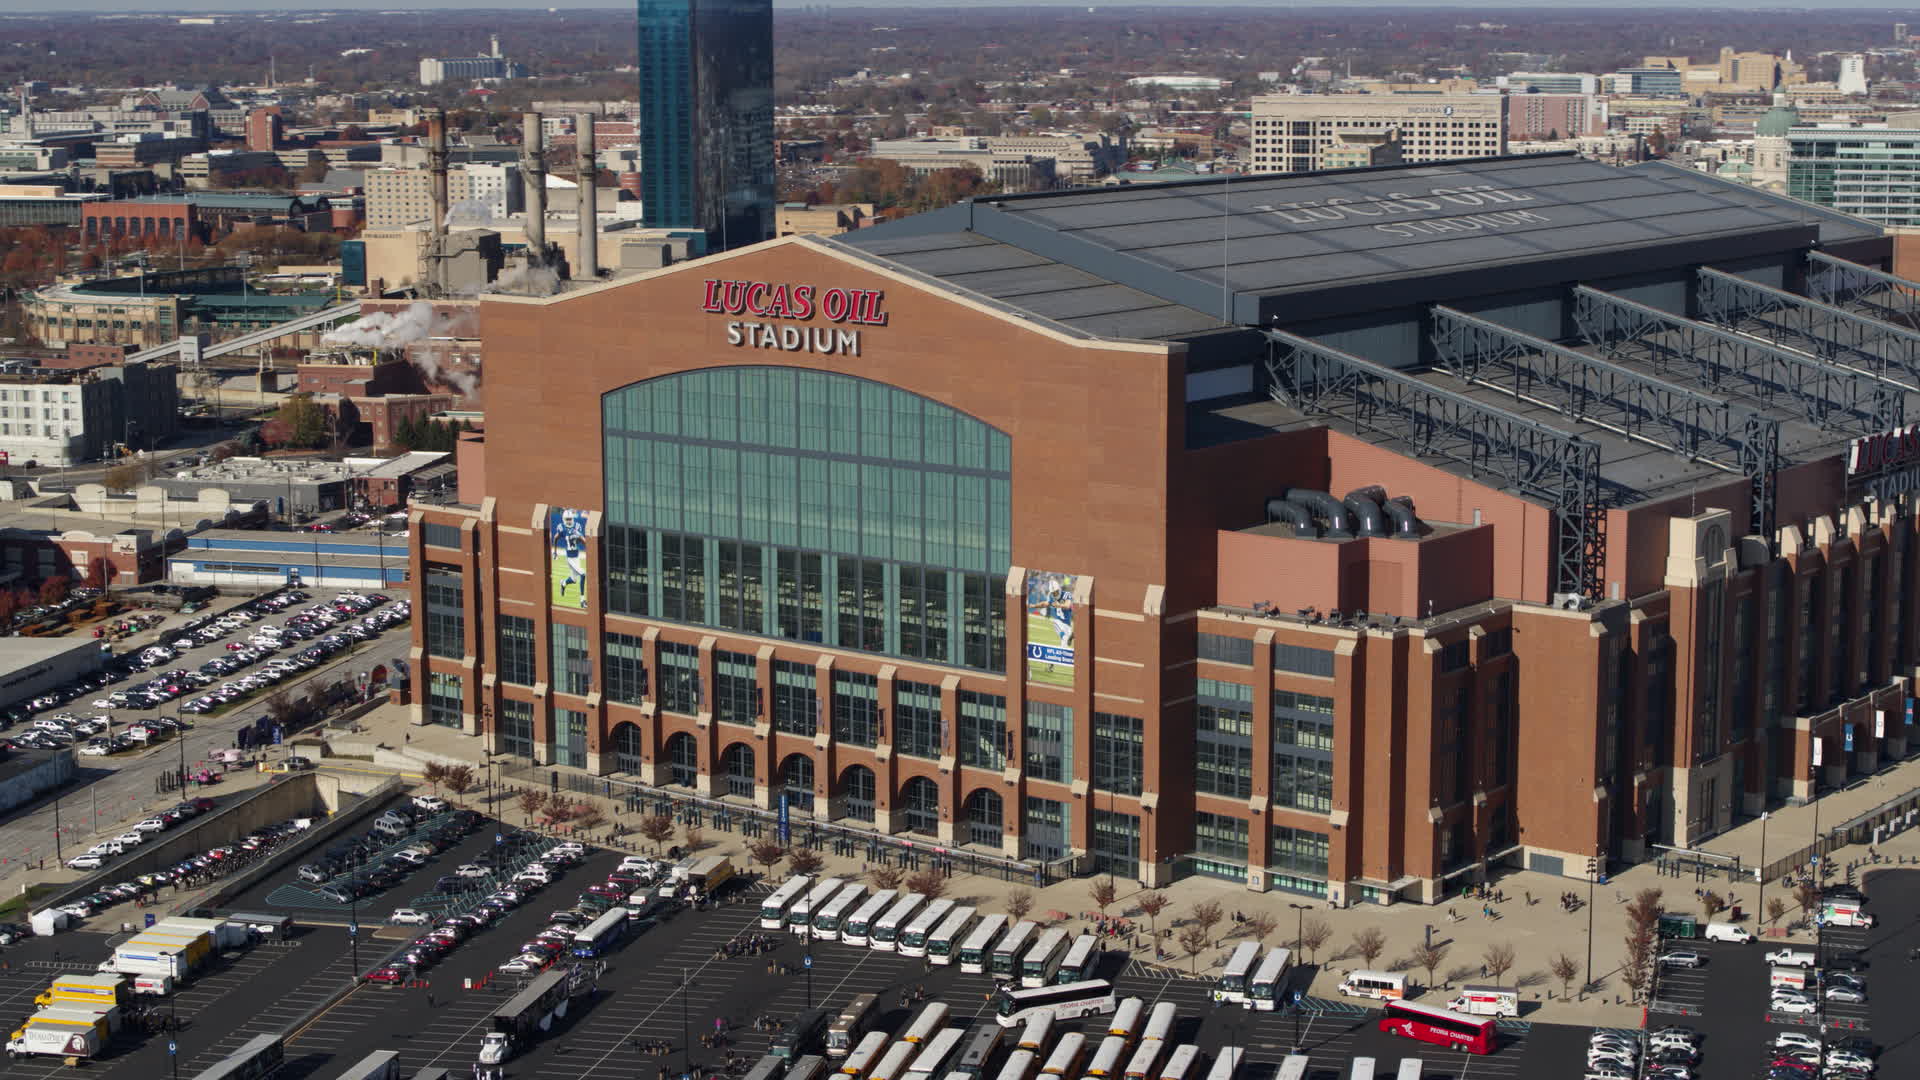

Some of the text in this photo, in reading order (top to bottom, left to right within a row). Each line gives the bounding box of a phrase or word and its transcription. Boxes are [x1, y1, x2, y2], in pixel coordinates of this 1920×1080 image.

[1255, 185, 1536, 224] LUCAS OIL
[1374, 210, 1551, 238] STADIUM
[703, 279, 887, 325] LUCAS OIL
[727, 321, 859, 357] STADIUM
